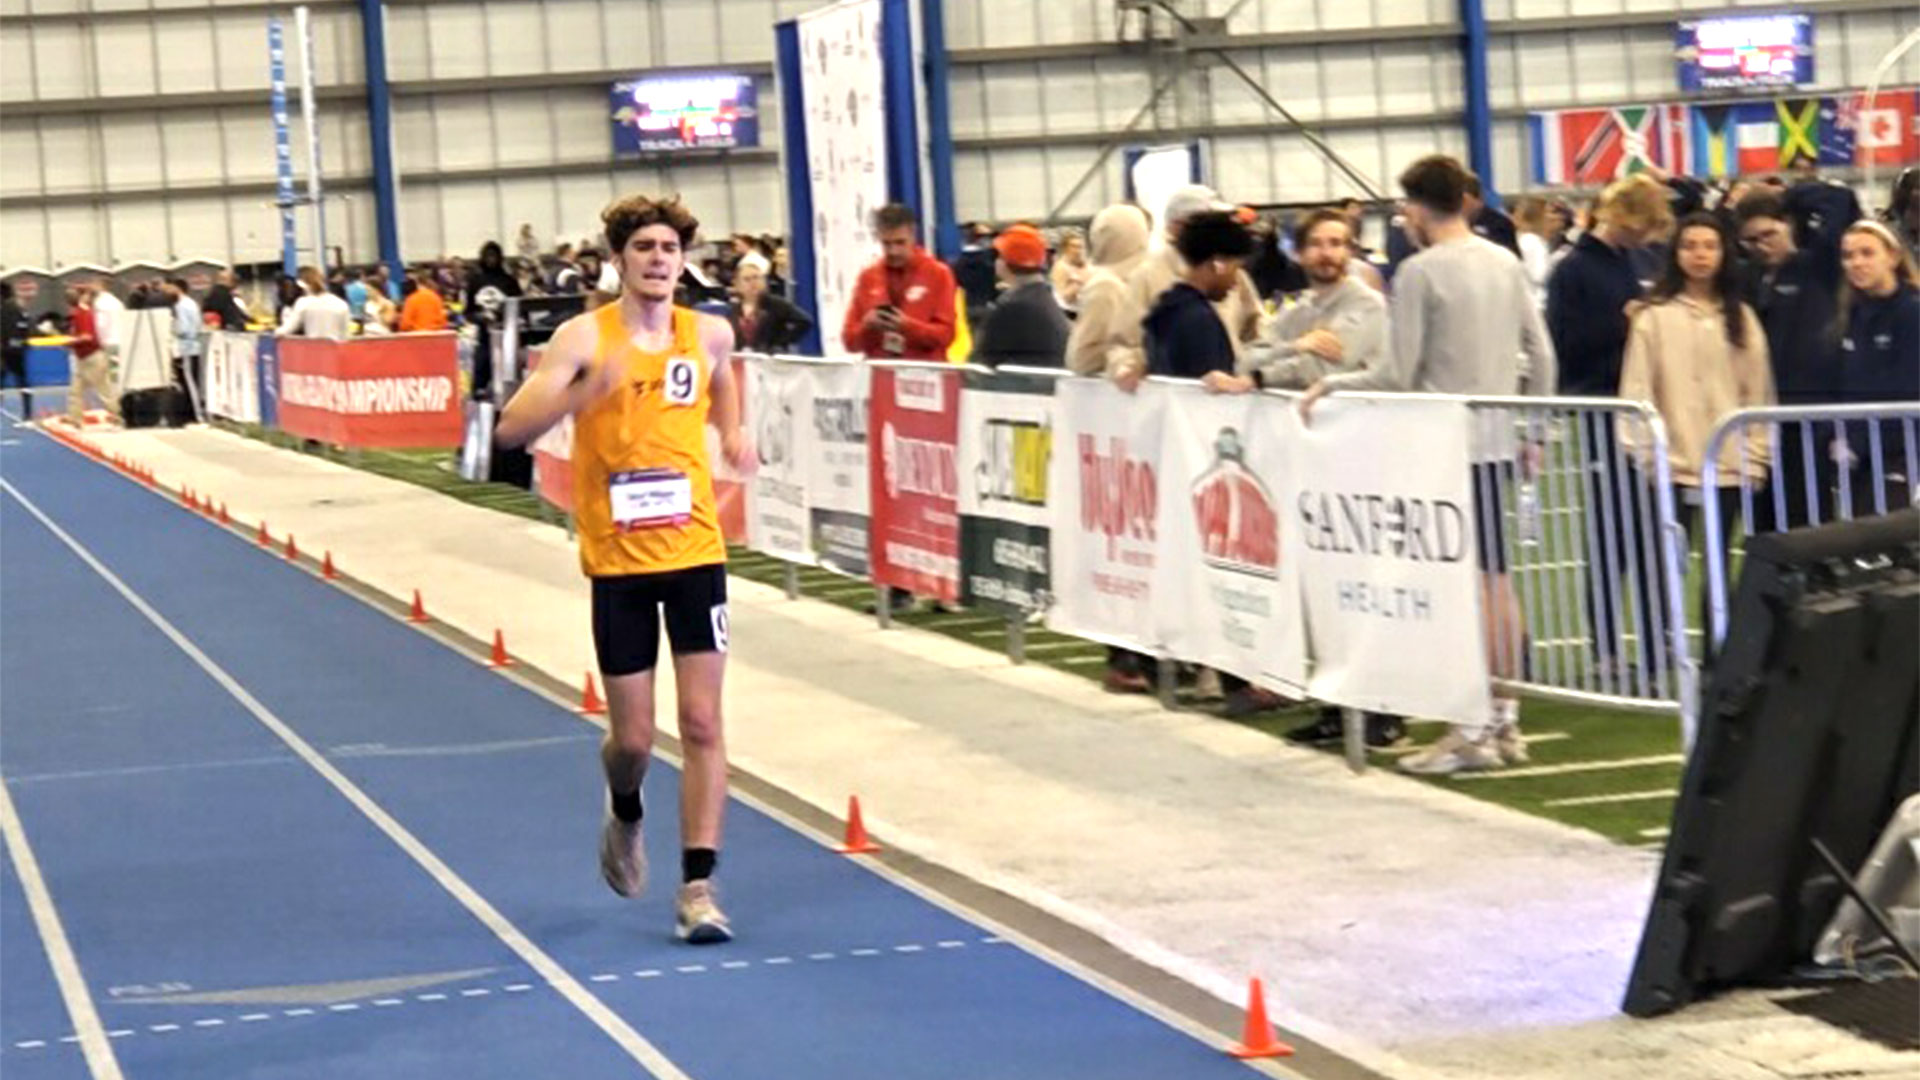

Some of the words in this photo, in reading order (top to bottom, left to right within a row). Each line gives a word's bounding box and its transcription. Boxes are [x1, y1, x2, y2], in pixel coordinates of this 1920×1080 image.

[671, 363, 692, 399] 9
[1298, 490, 1468, 563] SANFORD
[1337, 579, 1432, 620] HEALTH
